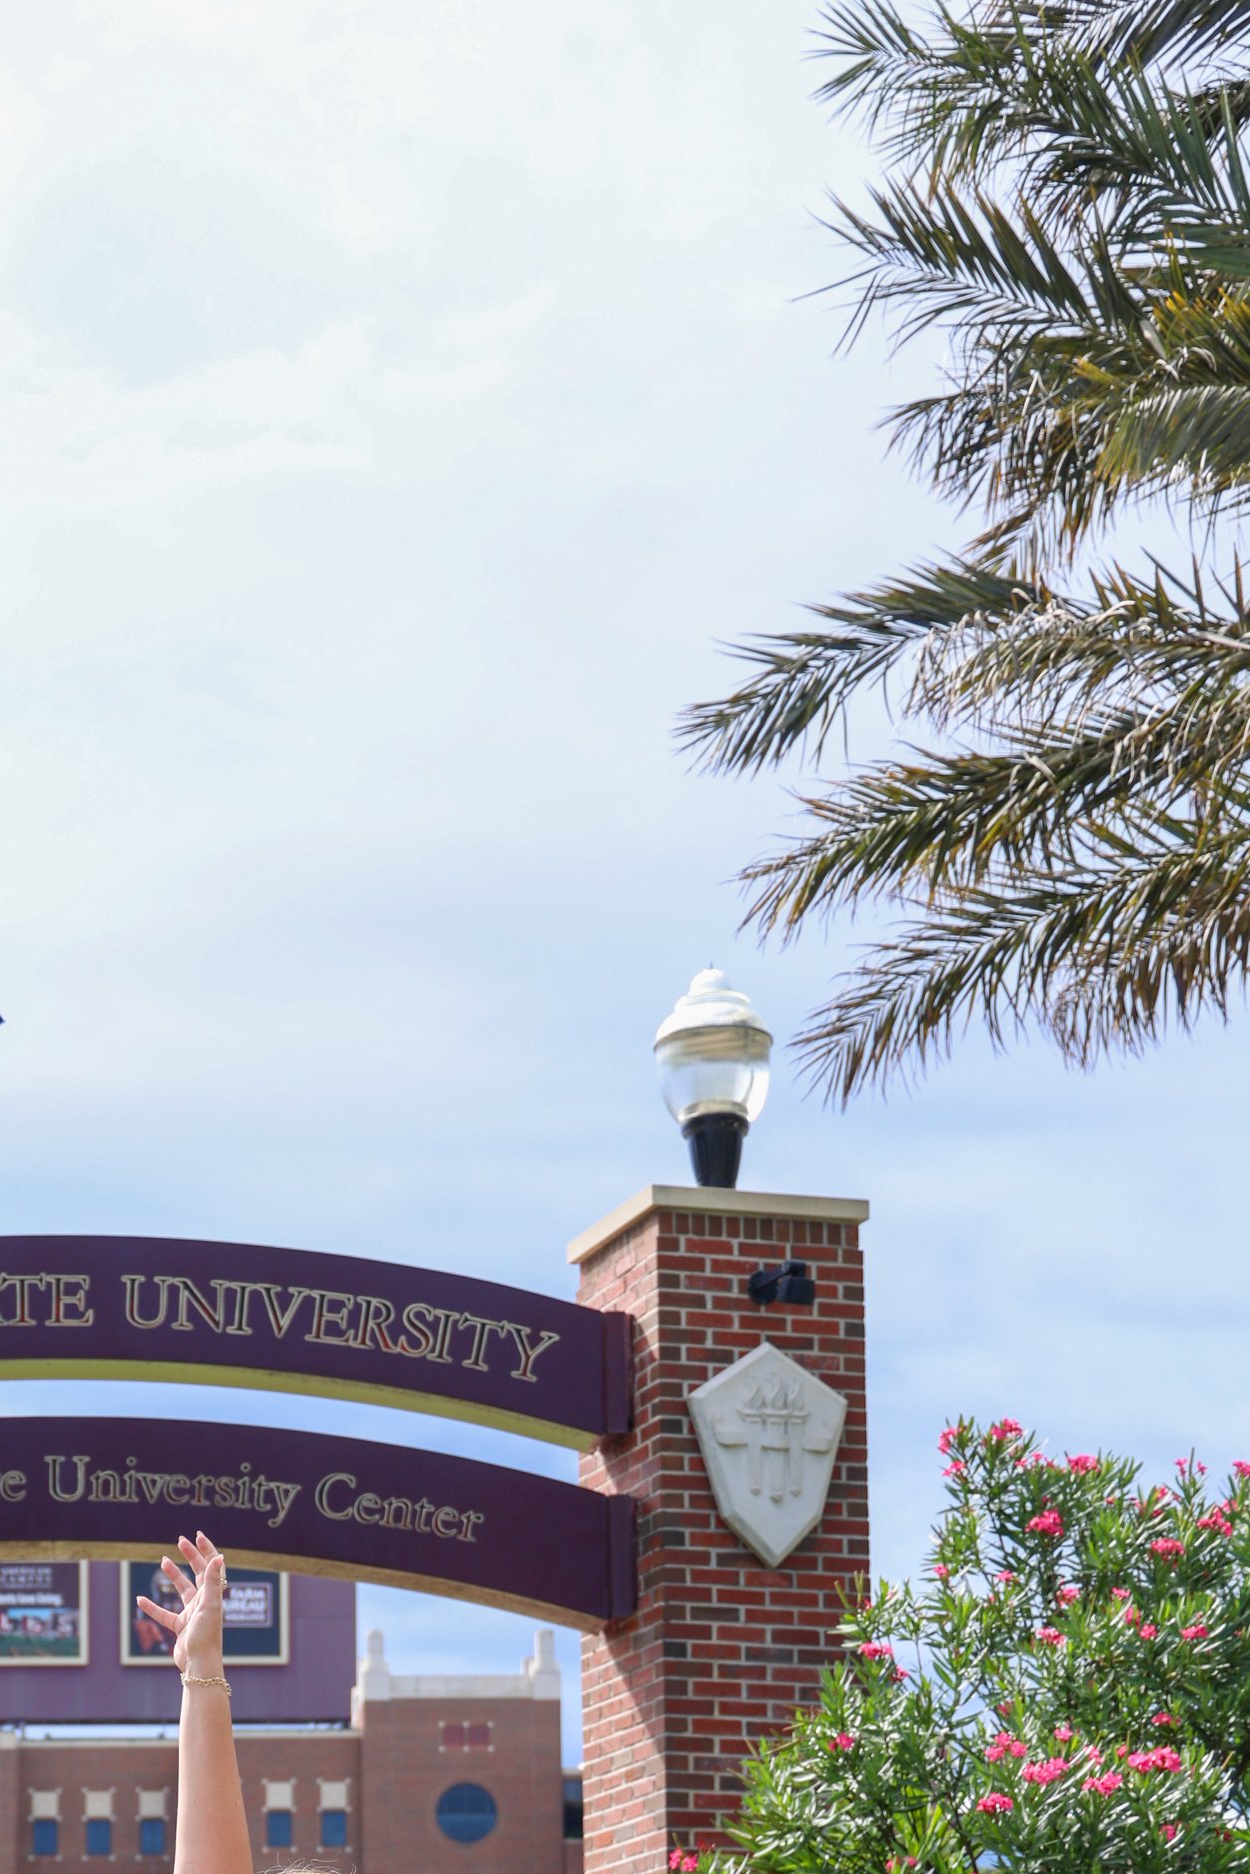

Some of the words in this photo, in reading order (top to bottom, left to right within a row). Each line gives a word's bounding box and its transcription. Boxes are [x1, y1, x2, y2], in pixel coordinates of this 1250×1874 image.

[121, 1274, 560, 1382] UNIVERSITY
[44, 1455, 302, 1527] University
[314, 1471, 485, 1542] Center
[222, 1599, 266, 1611] UREAU
